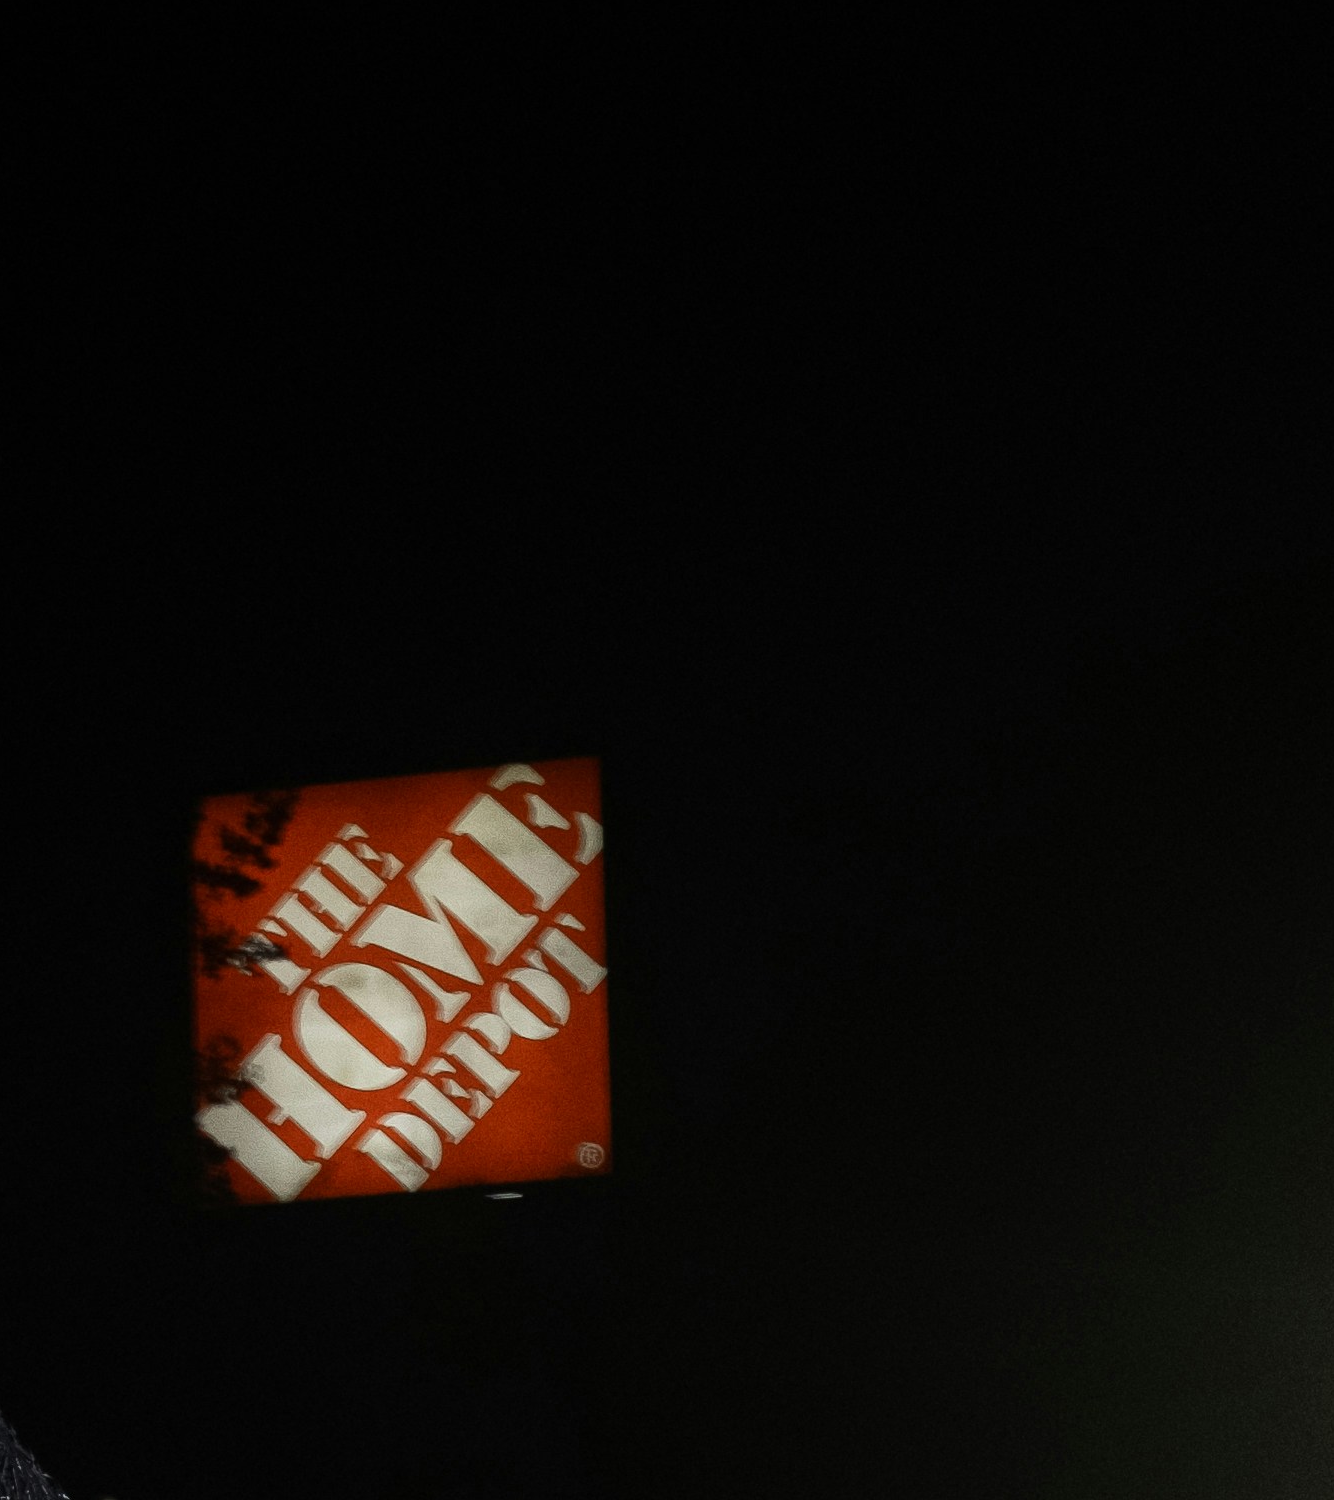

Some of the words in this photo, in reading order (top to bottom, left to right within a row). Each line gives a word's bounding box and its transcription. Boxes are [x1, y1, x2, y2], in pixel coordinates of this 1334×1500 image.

[195, 763, 604, 1202] HOME
[226, 823, 405, 995] THE
[354, 913, 608, 1192] DEPOT
